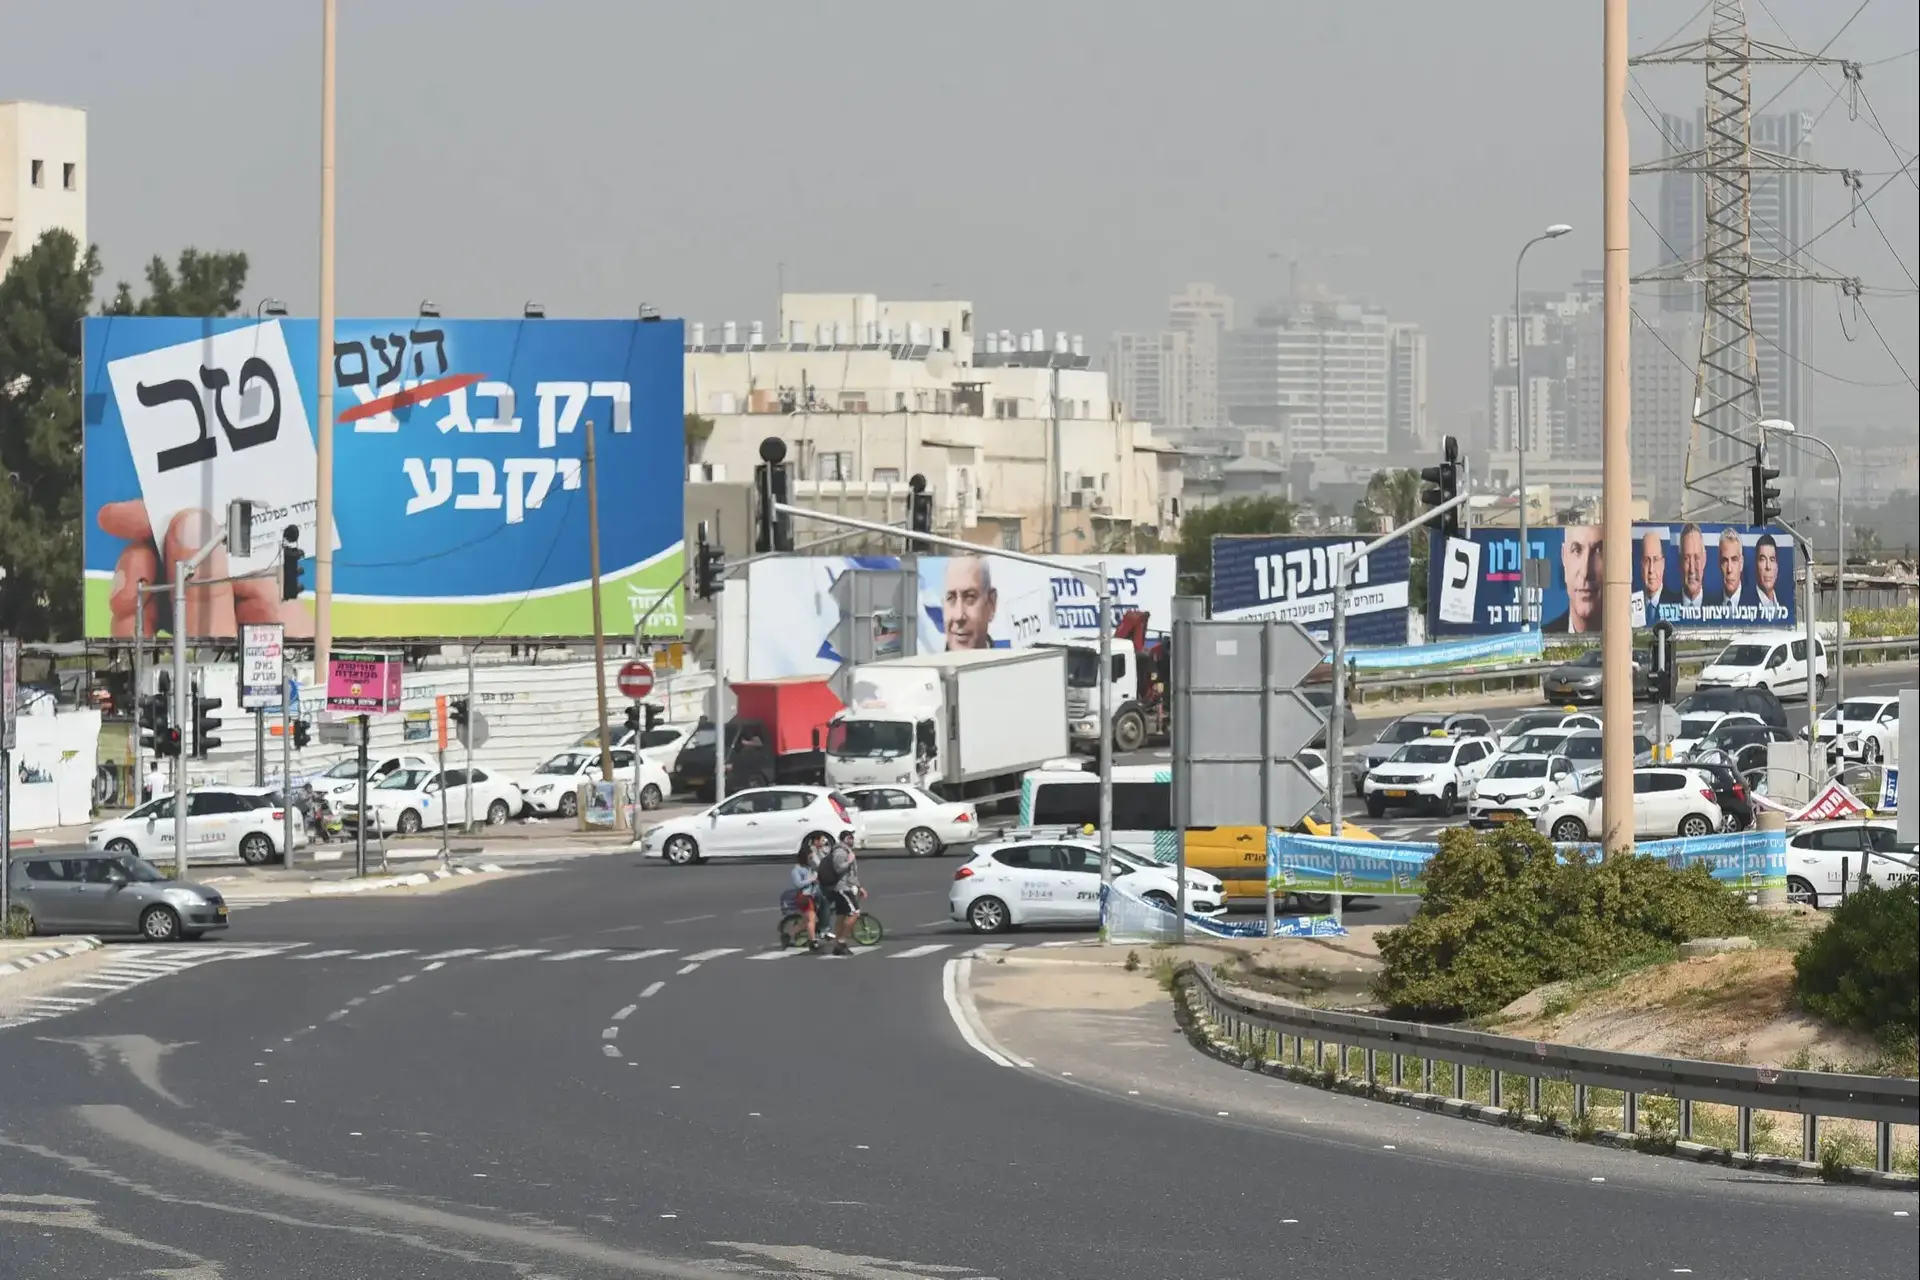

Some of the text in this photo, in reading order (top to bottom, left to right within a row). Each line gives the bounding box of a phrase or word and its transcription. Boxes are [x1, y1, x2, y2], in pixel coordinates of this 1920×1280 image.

[333, 329, 448, 387] העם
[137, 357, 281, 472] טב
[535, 381, 632, 449] רק
[291, 499, 317, 516] יחוד
[403, 458, 582, 524] יקבע
[1451, 548, 1470, 590] כ
